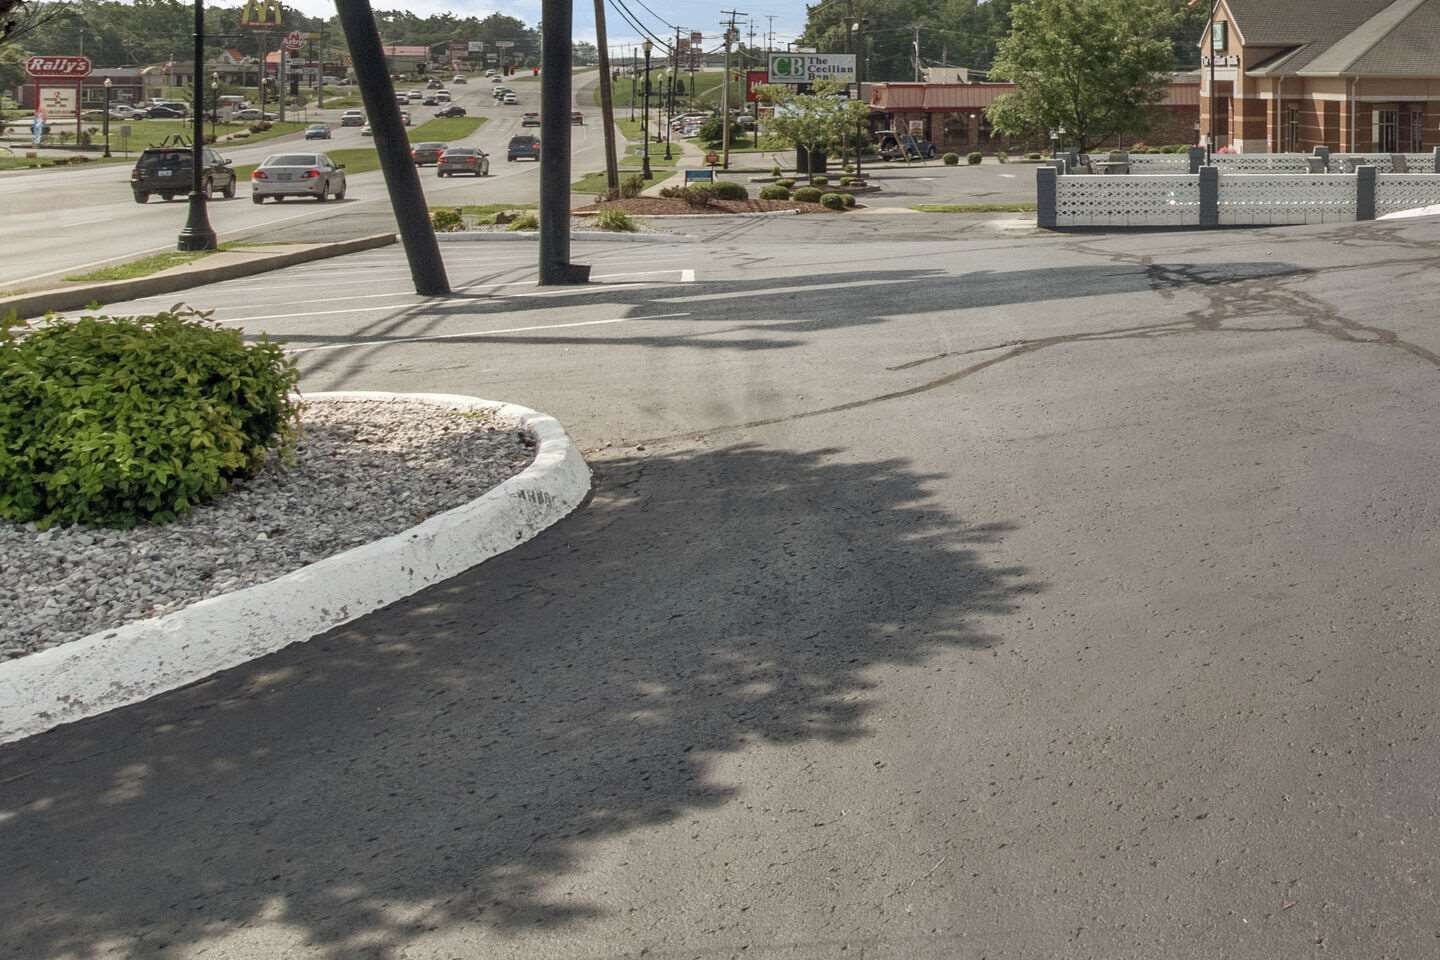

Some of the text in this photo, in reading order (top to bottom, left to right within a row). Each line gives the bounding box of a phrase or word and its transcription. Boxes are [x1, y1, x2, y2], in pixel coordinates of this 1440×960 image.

[807, 56, 828, 65] The
[29, 58, 86, 73] Rally's
[807, 65, 854, 73] Cecilian
